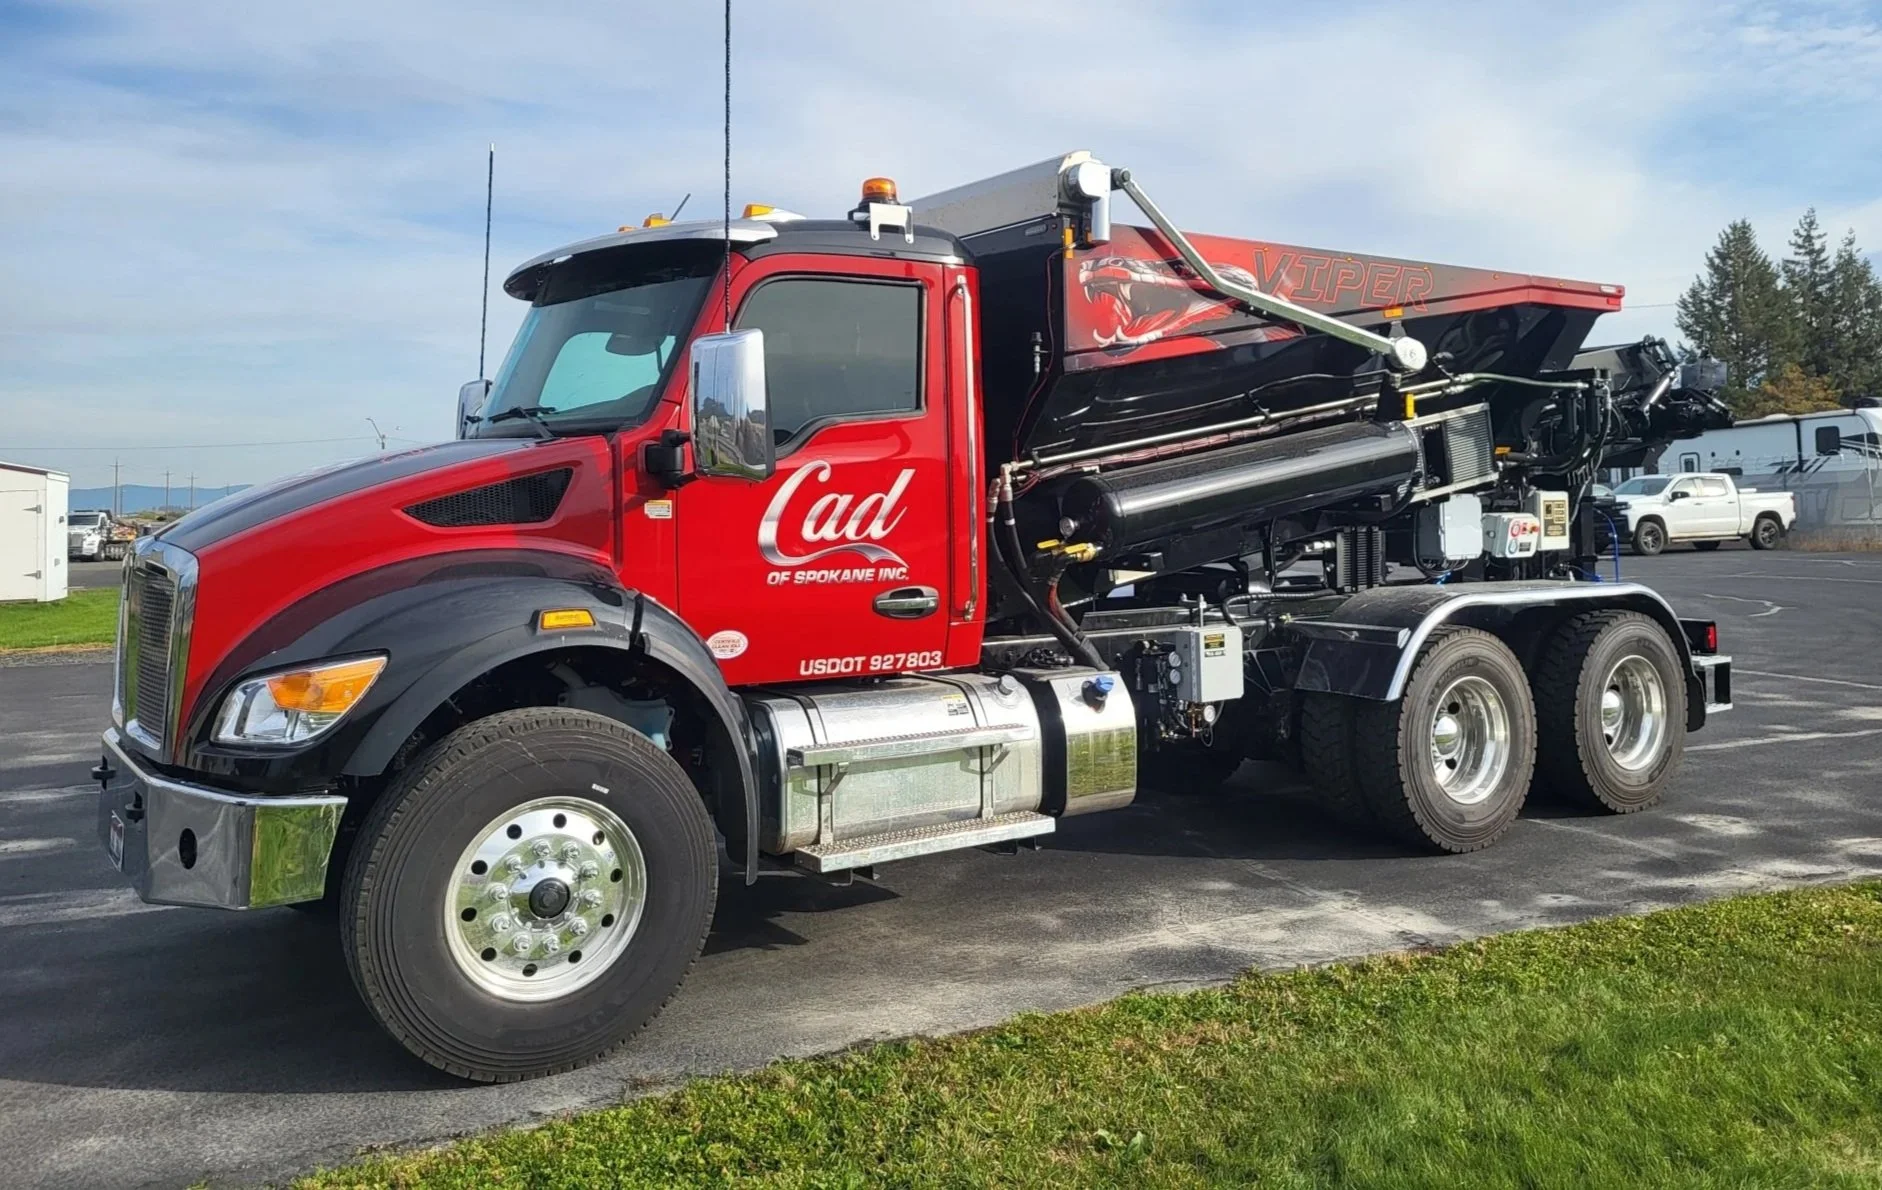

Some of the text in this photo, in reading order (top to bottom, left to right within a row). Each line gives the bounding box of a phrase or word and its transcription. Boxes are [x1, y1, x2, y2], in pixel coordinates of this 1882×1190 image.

[1253, 249, 1433, 312] VIPER
[757, 460, 916, 567] Cad
[767, 567, 910, 586] OF SPOKANE INC.
[800, 650, 942, 675] USDOT 927803
